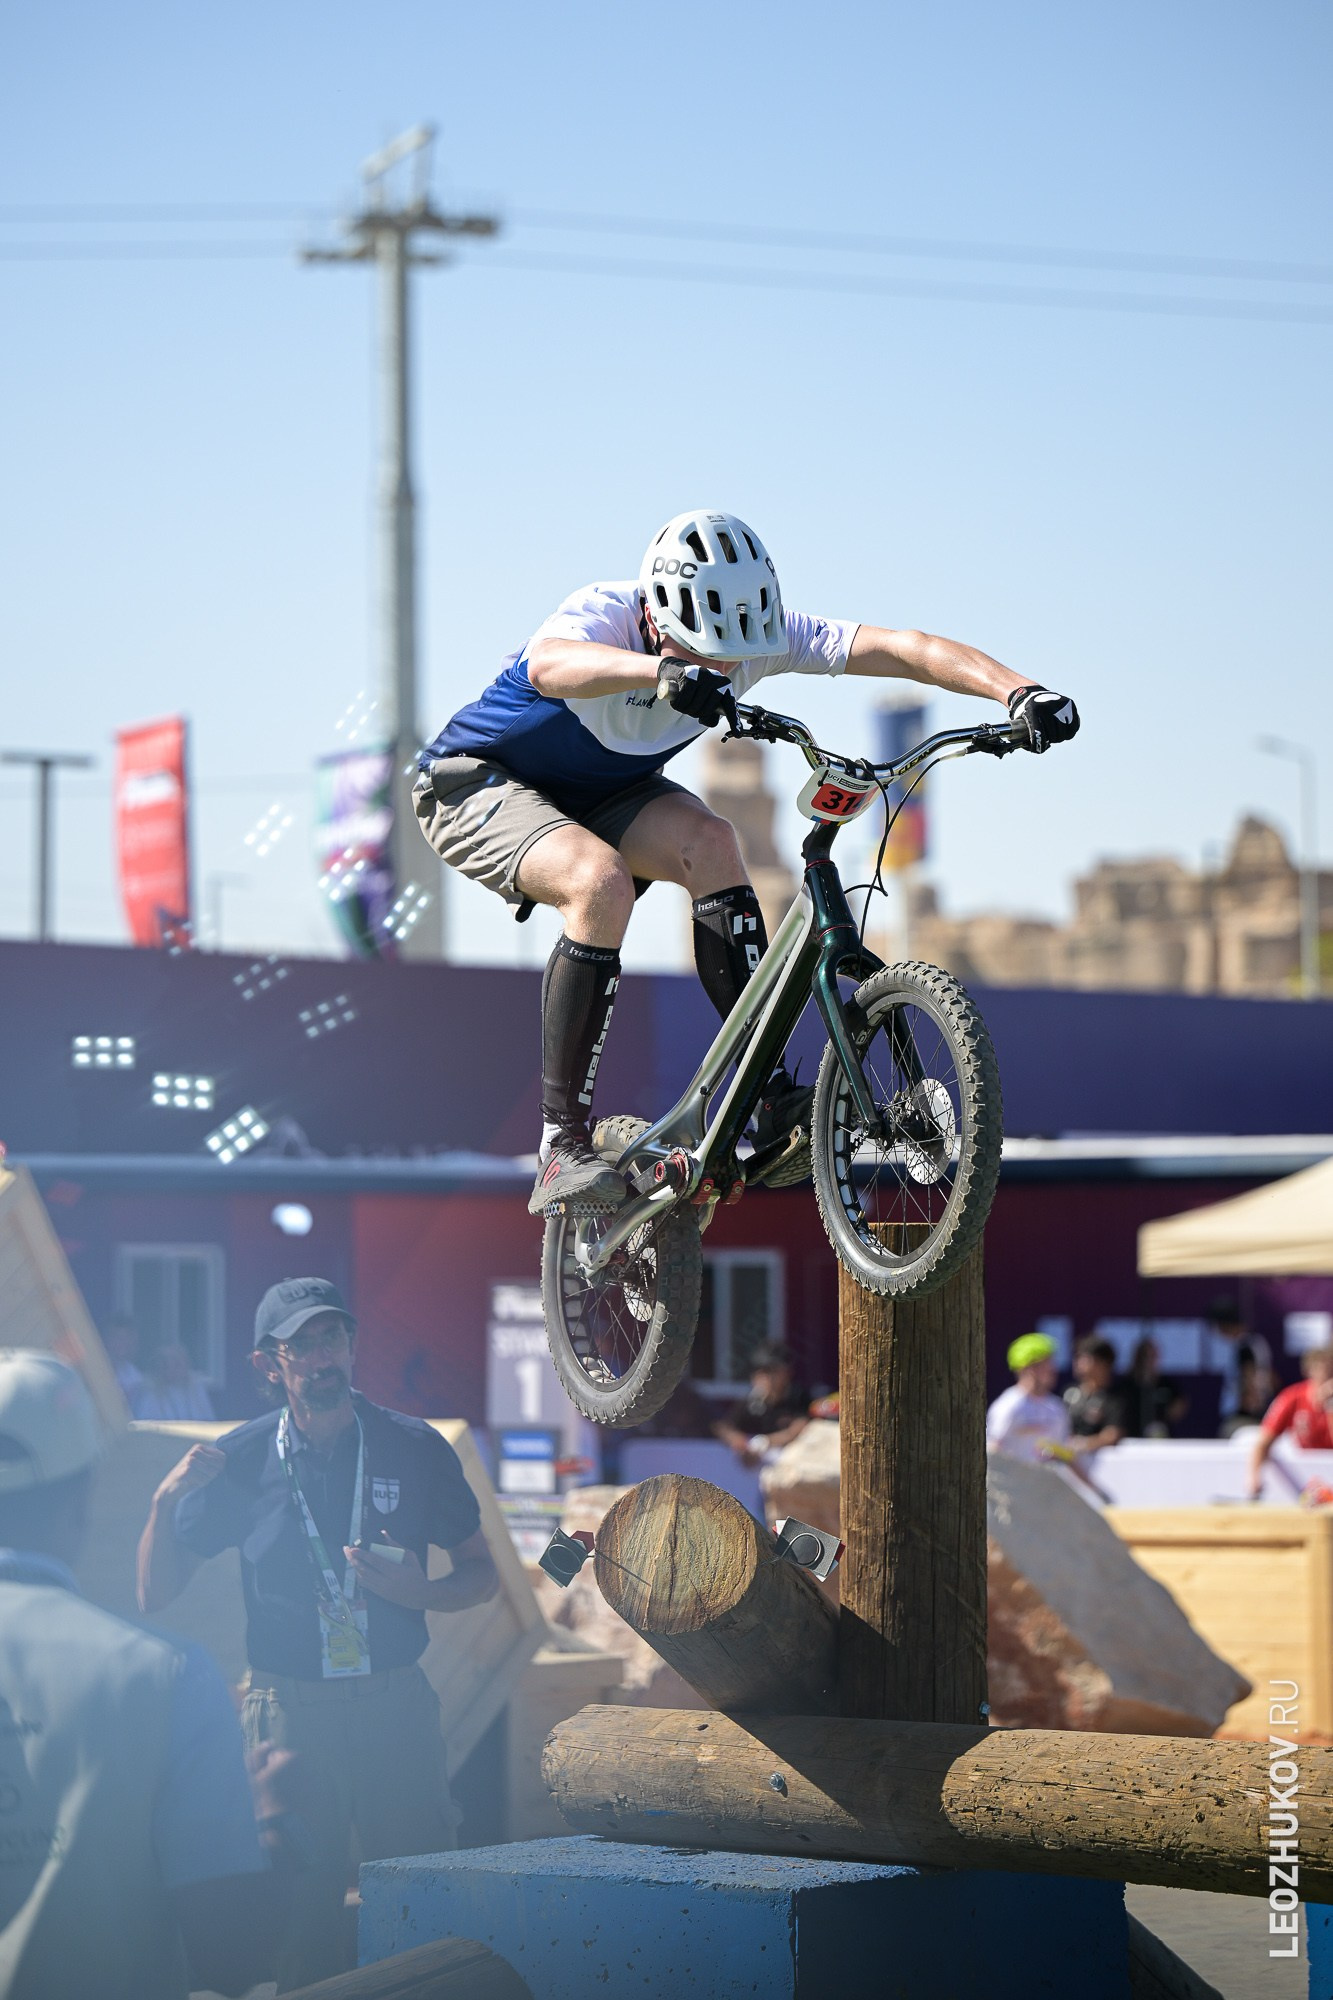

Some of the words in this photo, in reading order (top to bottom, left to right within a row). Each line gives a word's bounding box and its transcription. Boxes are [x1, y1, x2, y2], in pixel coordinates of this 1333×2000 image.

[828, 773, 840, 783] UCI
[697, 894, 735, 912] hebo
[569, 946, 615, 961] hebo
